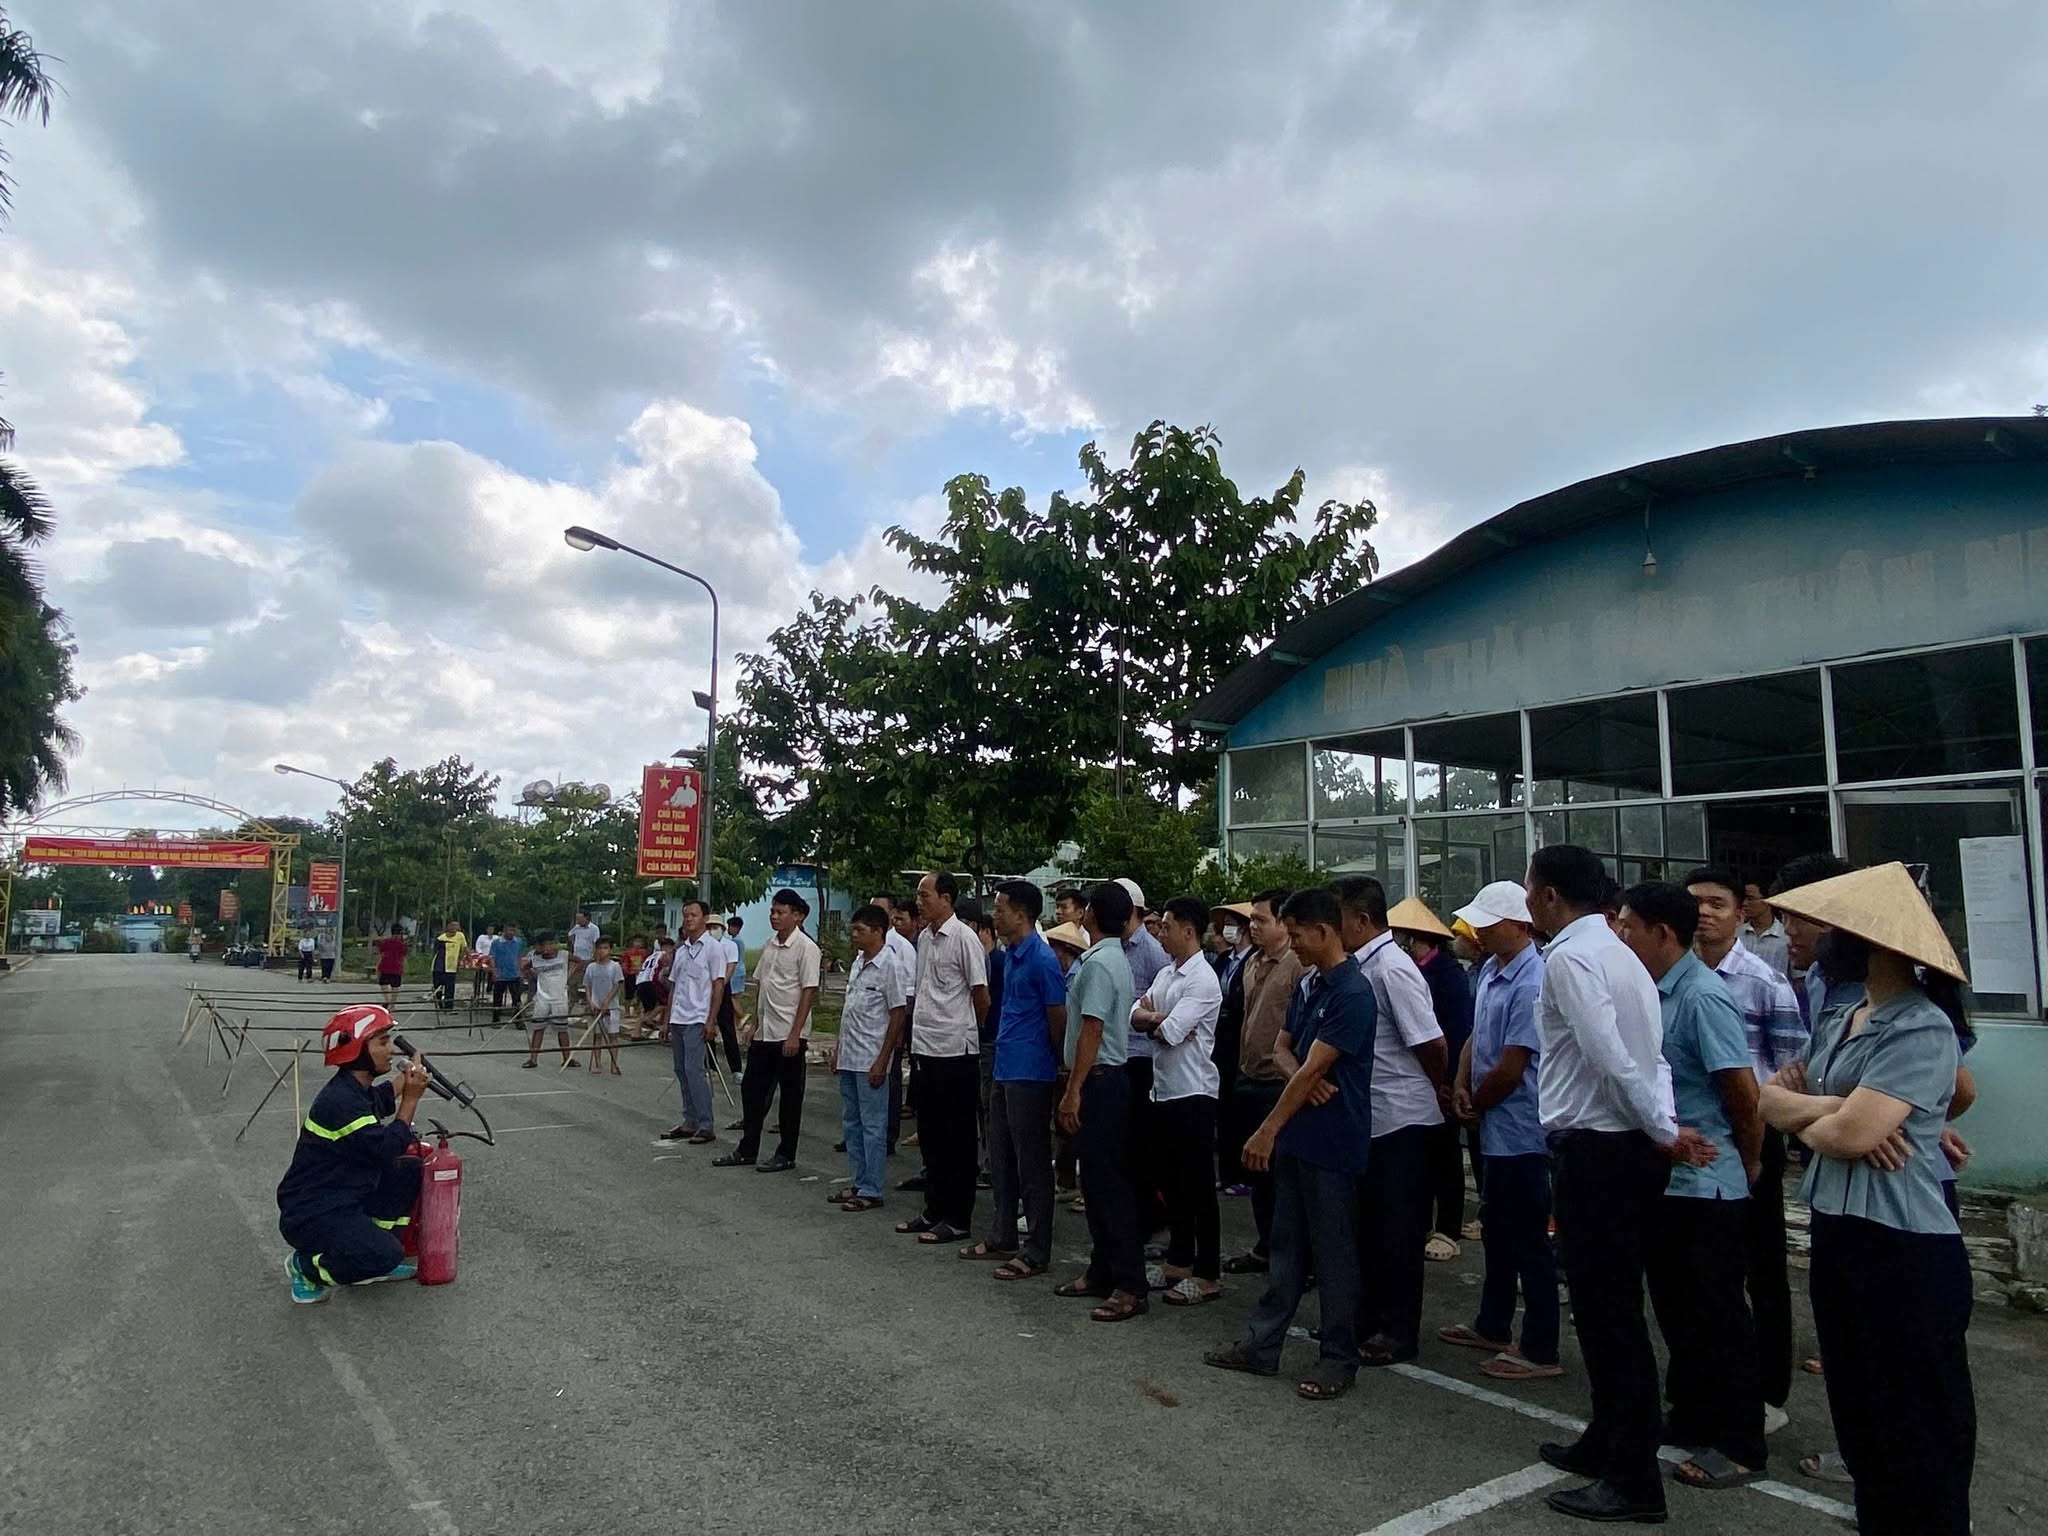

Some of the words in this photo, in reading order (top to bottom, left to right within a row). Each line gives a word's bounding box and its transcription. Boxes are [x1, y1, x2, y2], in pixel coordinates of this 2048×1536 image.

[1324, 645, 1410, 714] NHÀ
[658, 808, 671, 818] CHỦ
[672, 809, 686, 820] TỊCH
[652, 820, 661, 831] HỒ
[662, 821, 673, 831] CHÍ
[656, 833, 672, 844] SỐNG
[673, 835, 685, 845] MÃI
[664, 849, 673, 860] SỰ
[647, 861, 659, 871] CỦA
[661, 861, 681, 872] CHÚNG
[683, 864, 690, 872] TA
